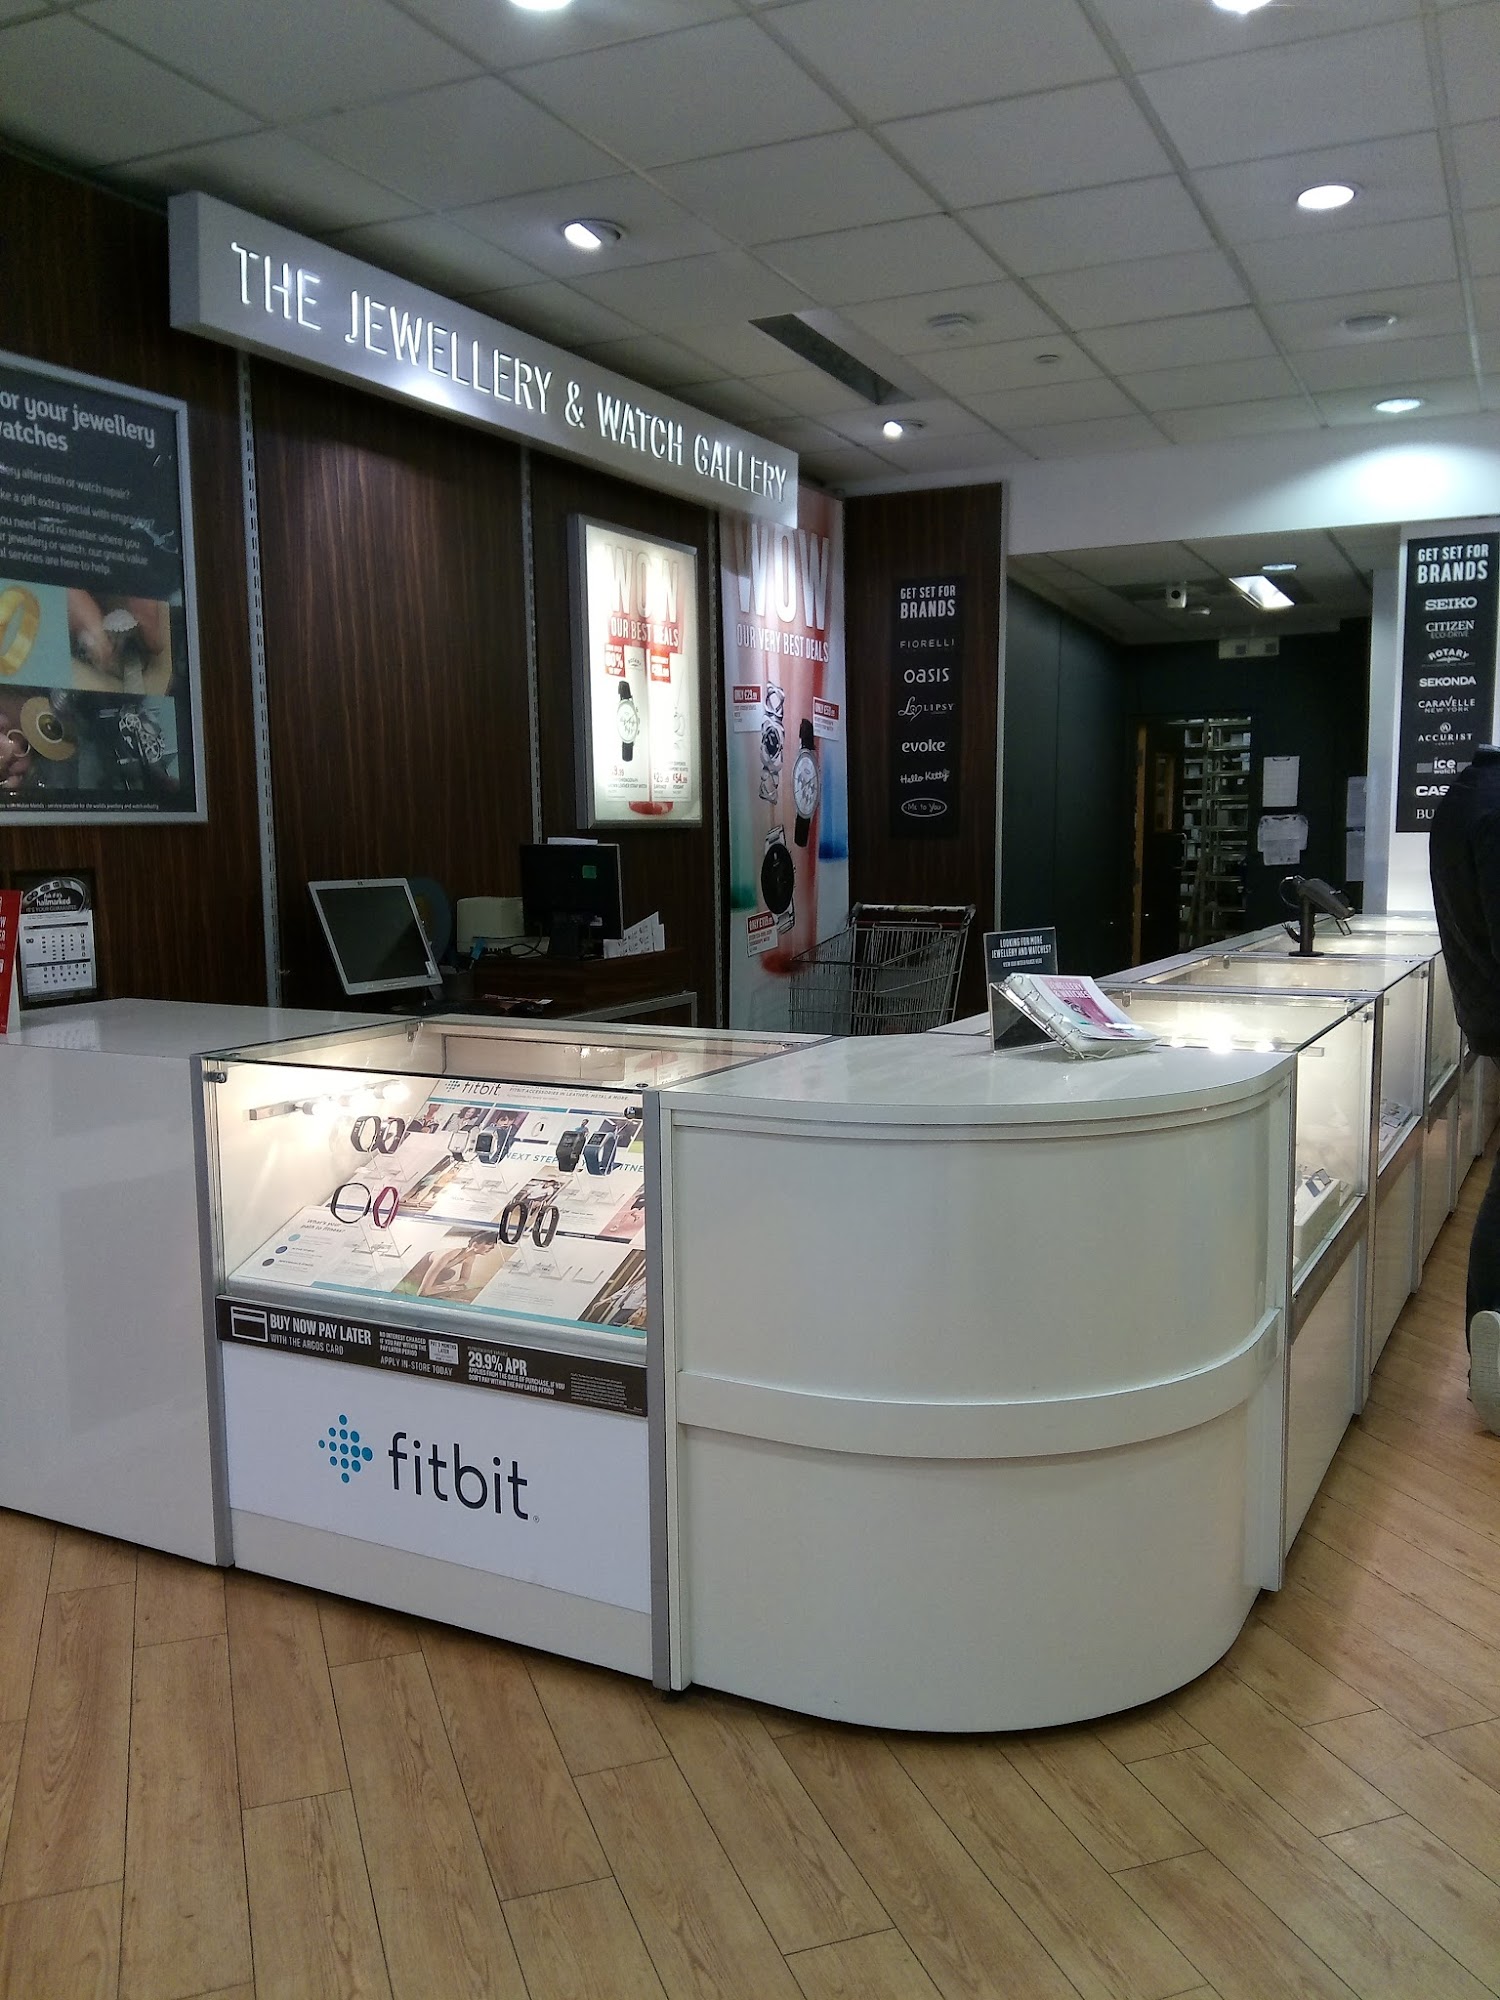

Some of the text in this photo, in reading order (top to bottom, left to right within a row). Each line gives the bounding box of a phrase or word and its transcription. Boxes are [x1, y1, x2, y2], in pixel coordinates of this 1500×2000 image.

[231, 241, 787, 503] THE JEWELLERY & WATCH GALLERY
[0, 391, 155, 449] or your jewellery
[0, 489, 12, 499] ke
[21, 493, 37, 506] gift
[62, 501, 91, 514] special
[0, 515, 11, 526] ou
[14, 518, 36, 530] need
[38, 524, 54, 534] and
[56, 527, 68, 536] no
[125, 540, 140, 549] you
[1418, 544, 1489, 561] GET SET FOR
[9, 551, 44, 564] services
[45, 555, 59, 566] are
[60, 556, 80, 570] here
[735, 520, 829, 631] WOW
[1418, 560, 1488, 584] BRANDS
[901, 585, 956, 600] GET SET FOR
[900, 599, 955, 619] BRANDS
[1425, 597, 1477, 610] SEIKO
[610, 616, 629, 639] OUR
[630, 620, 651, 642] BEST
[1426, 620, 1475, 632] CITIZEN
[737, 623, 828, 663] OUR VERY BEST DEALS
[900, 638, 954, 648] FIORELLI
[1428, 648, 1470, 660] ROTARY
[1420, 676, 1477, 687] SEKONDA
[1418, 696, 1476, 708] CARAVELLE
[1418, 733, 1473, 741] ACCURIST
[901, 739, 946, 752] evoke
[1434, 757, 1456, 769] ice
[900, 770, 949, 783] Hello Kitty
[1415, 785, 1450, 796] CAS
[928, 803, 941, 812] You
[1416, 809, 1435, 819] BU
[1000, 935, 1042, 948] LOOKING FOR MORE
[991, 944, 1051, 958] JEWELLERY AND WATCHES?
[462, 1082, 501, 1096] fitbit
[506, 1152, 531, 1161] NEXT
[270, 1313, 372, 1346] BUY NOW PAY LATER
[271, 1334, 344, 1355] WITH THE ARGOS CARD
[386, 1333, 406, 1341] INTEREST
[406, 1336, 426, 1344] CHARGED
[402, 1342, 418, 1350] WITHIN
[402, 1348, 417, 1357] PERIOD
[380, 1356, 453, 1376] APPLY IN-STORE TODAY
[468, 1351, 503, 1372] 29.9%
[505, 1357, 527, 1376] APR
[468, 1367, 486, 1375] APPLIES
[486, 1369, 498, 1378] FROM
[499, 1371, 507, 1379] THE
[508, 1373, 519, 1381] DATE
[555, 1382, 565, 1390] YOU
[490, 1377, 506, 1386] WITHIN
[524, 1383, 538, 1392] LATER
[538, 1386, 554, 1395] PERIOD
[388, 1431, 528, 1520] fitbit
